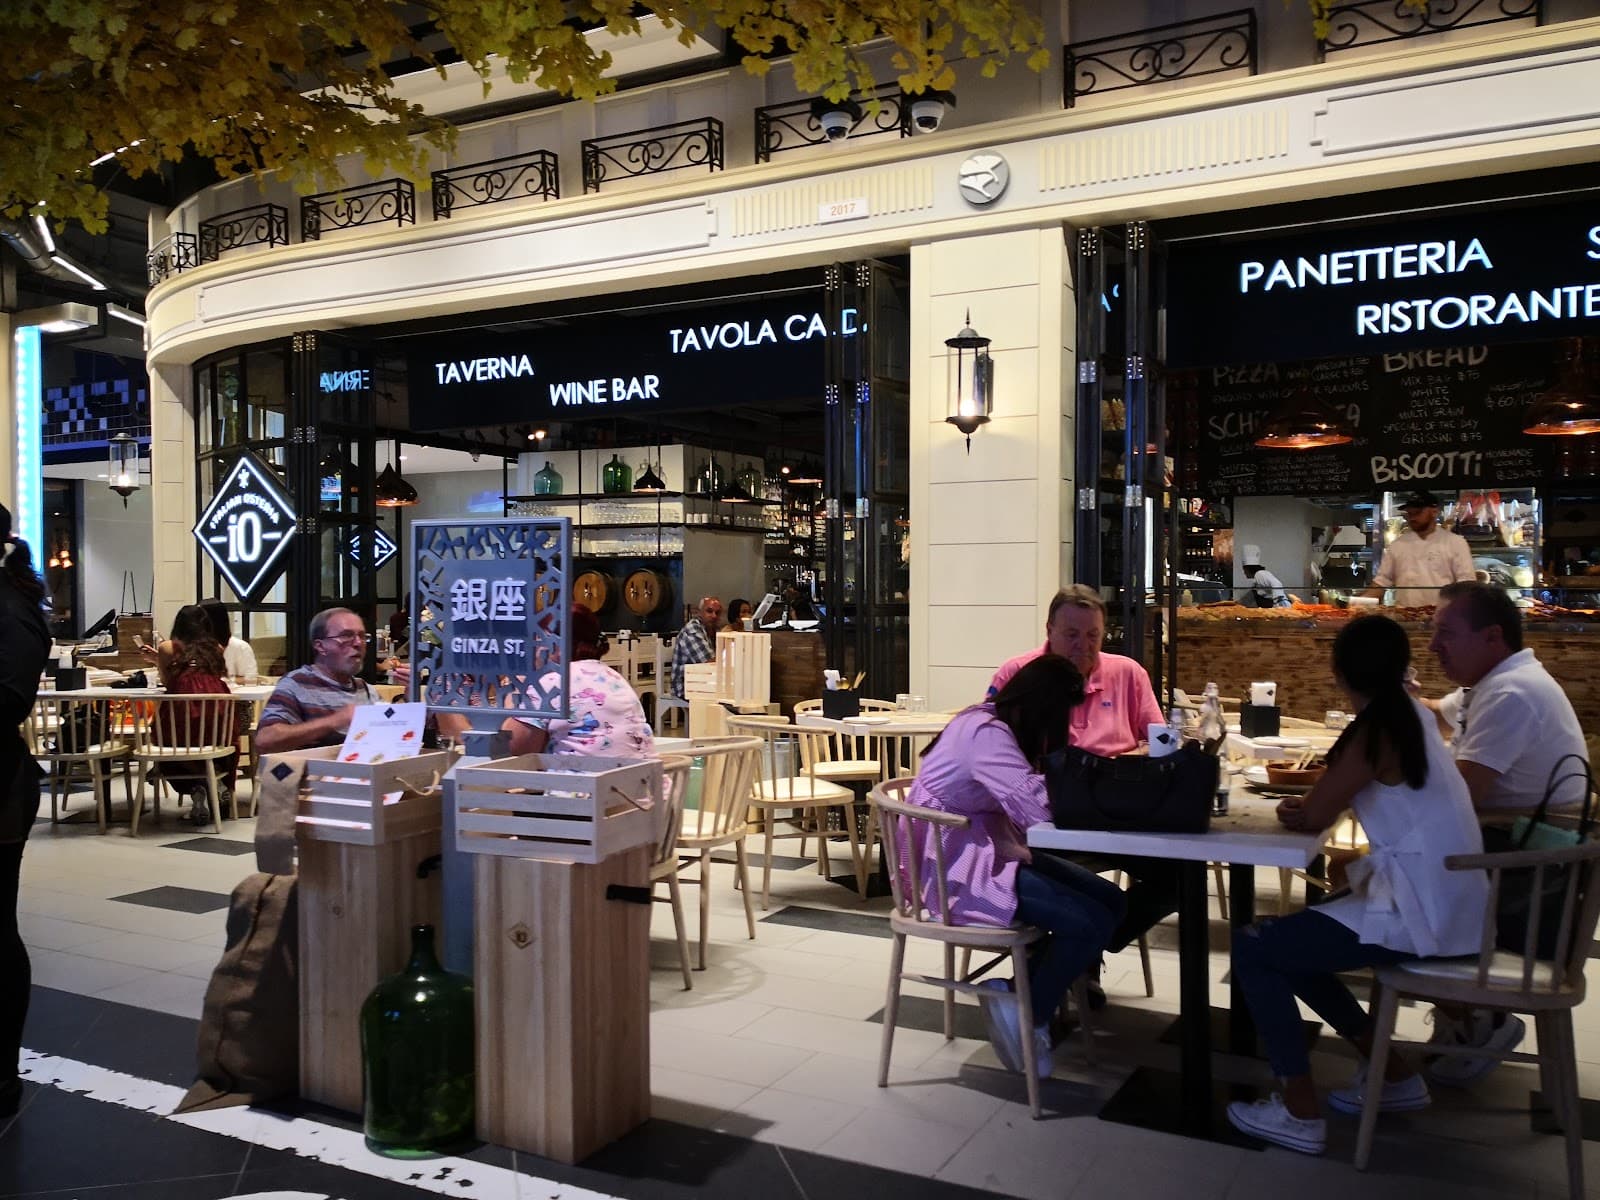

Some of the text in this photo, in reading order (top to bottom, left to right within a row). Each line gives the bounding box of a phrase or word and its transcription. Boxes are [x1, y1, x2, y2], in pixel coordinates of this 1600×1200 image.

[831, 203, 855, 216] 2017
[1240, 238, 1493, 293] PANETTERIA
[1356, 285, 1600, 336] RISTORANTE
[669, 319, 778, 354] TAVOLA
[436, 354, 535, 385] TAVERNA
[1382, 345, 1488, 373] BREAD
[549, 374, 660, 407] WINE BAR
[450, 577, 527, 622] 銀座
[451, 637, 499, 654] GINZA
